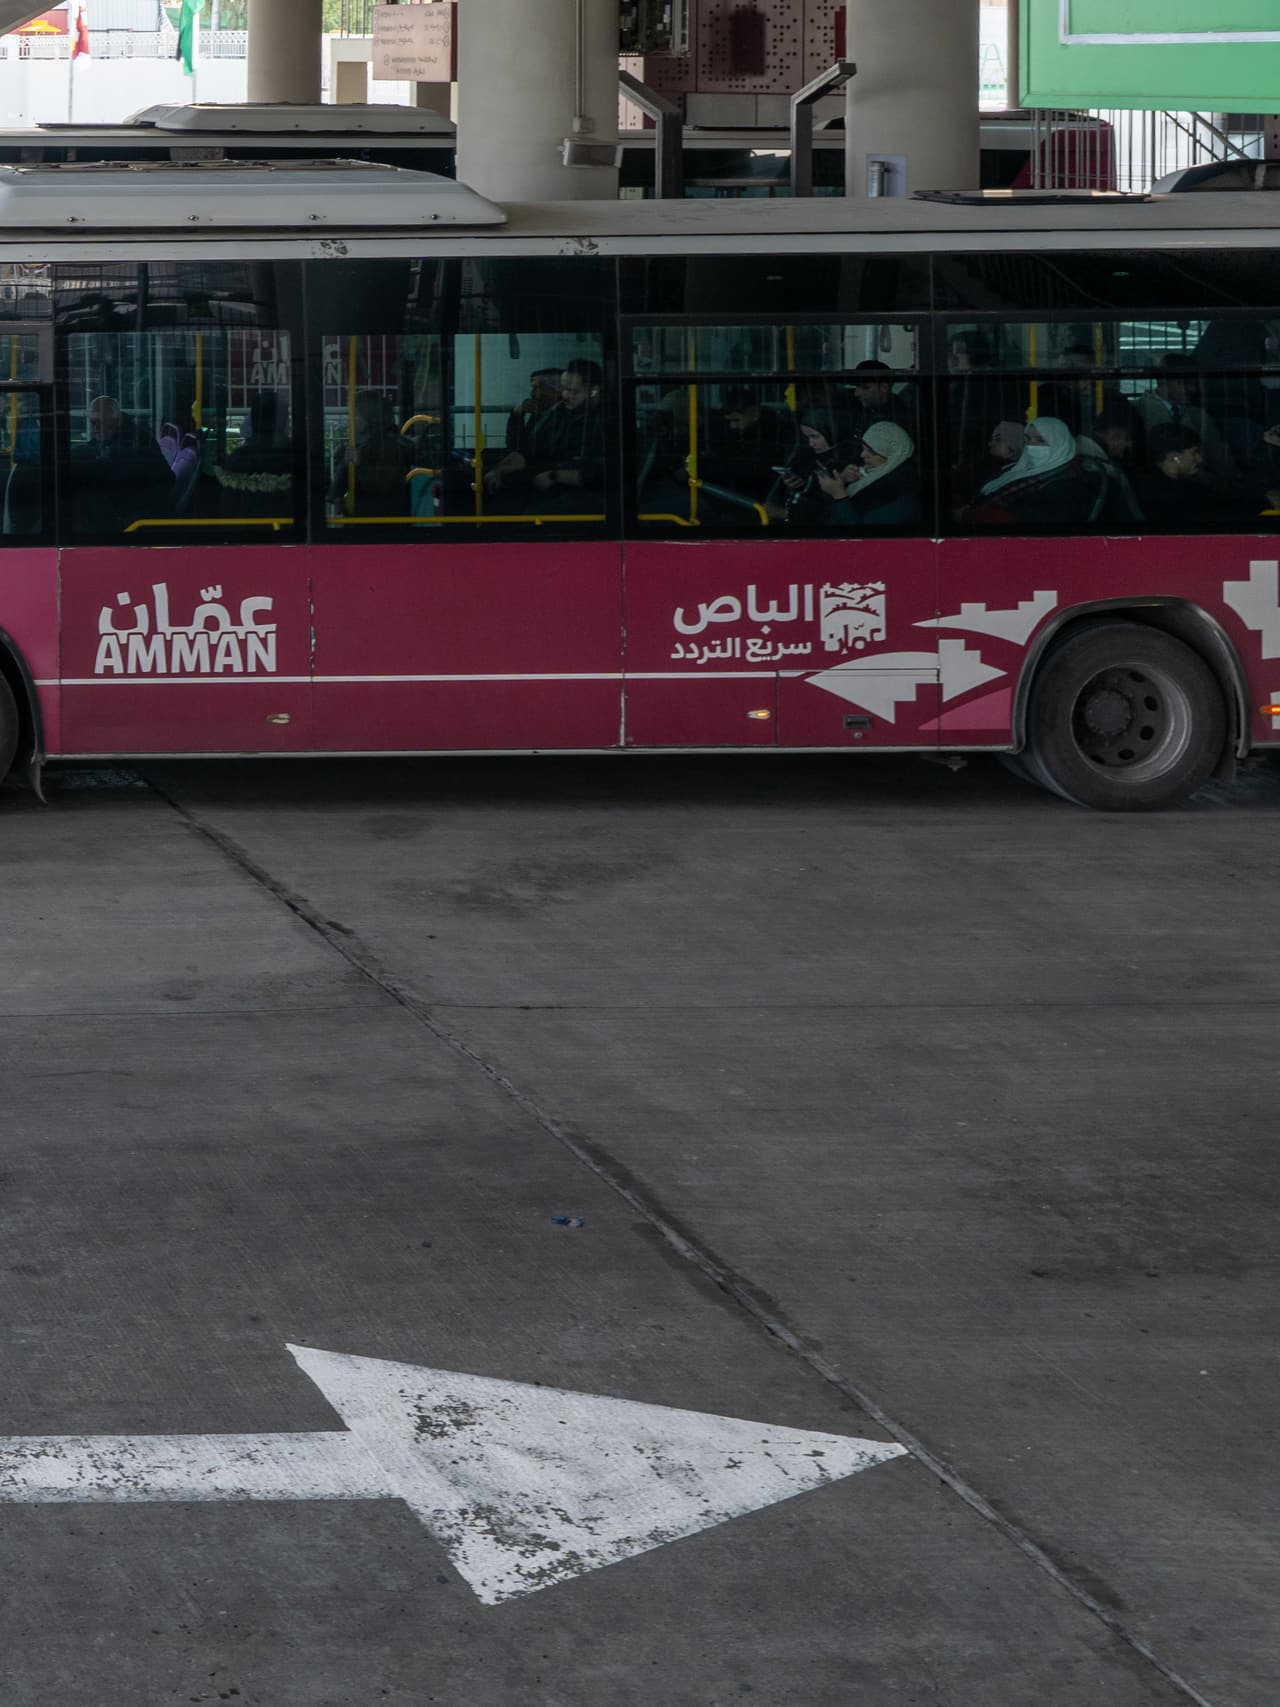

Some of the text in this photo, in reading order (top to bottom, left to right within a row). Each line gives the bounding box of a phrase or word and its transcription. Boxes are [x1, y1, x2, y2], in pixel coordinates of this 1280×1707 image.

[673, 584, 814, 635] الباص
[94, 632, 277, 674] AMMAN
[670, 637, 812, 664] سريع التردد
